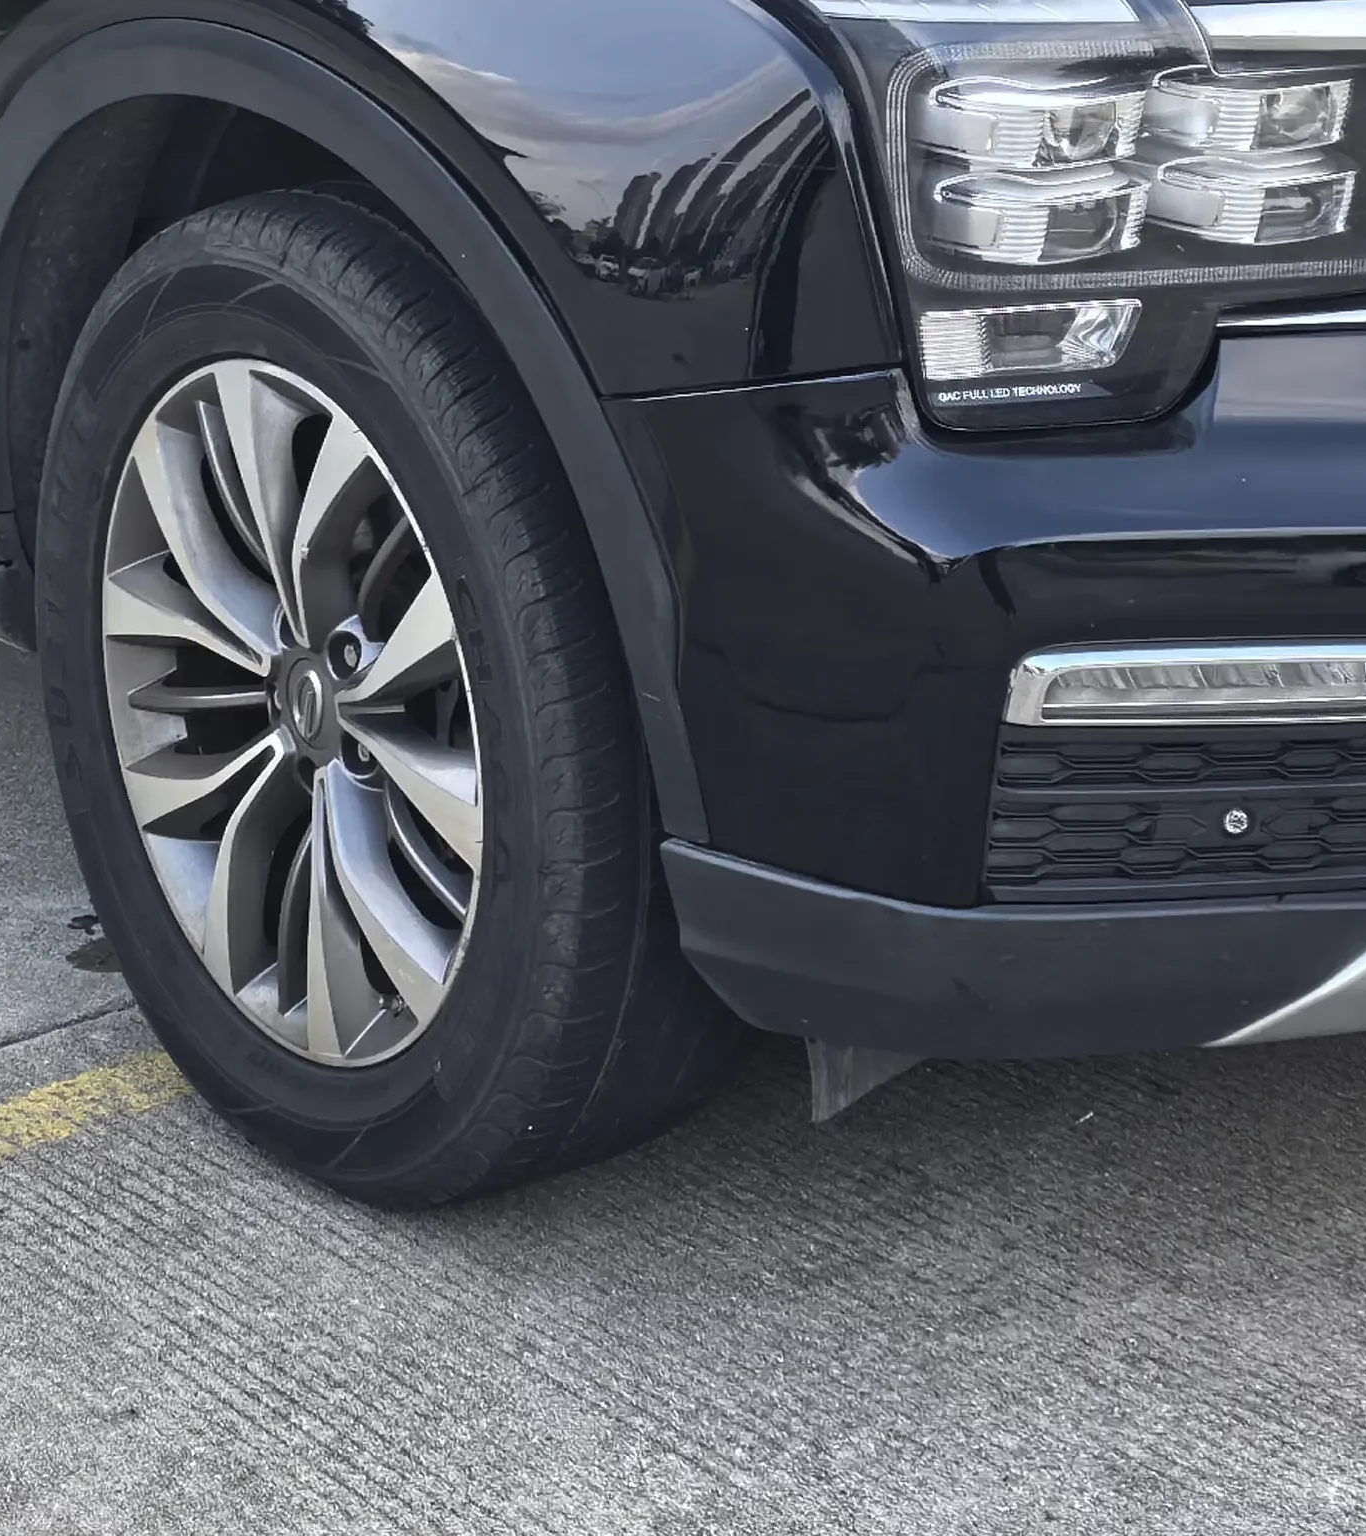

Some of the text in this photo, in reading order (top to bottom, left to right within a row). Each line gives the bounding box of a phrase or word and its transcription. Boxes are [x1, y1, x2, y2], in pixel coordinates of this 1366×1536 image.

[962, 389, 988, 400] FULL
[990, 387, 1010, 398] LED
[1012, 383, 1082, 397] TECHNOLOGY
